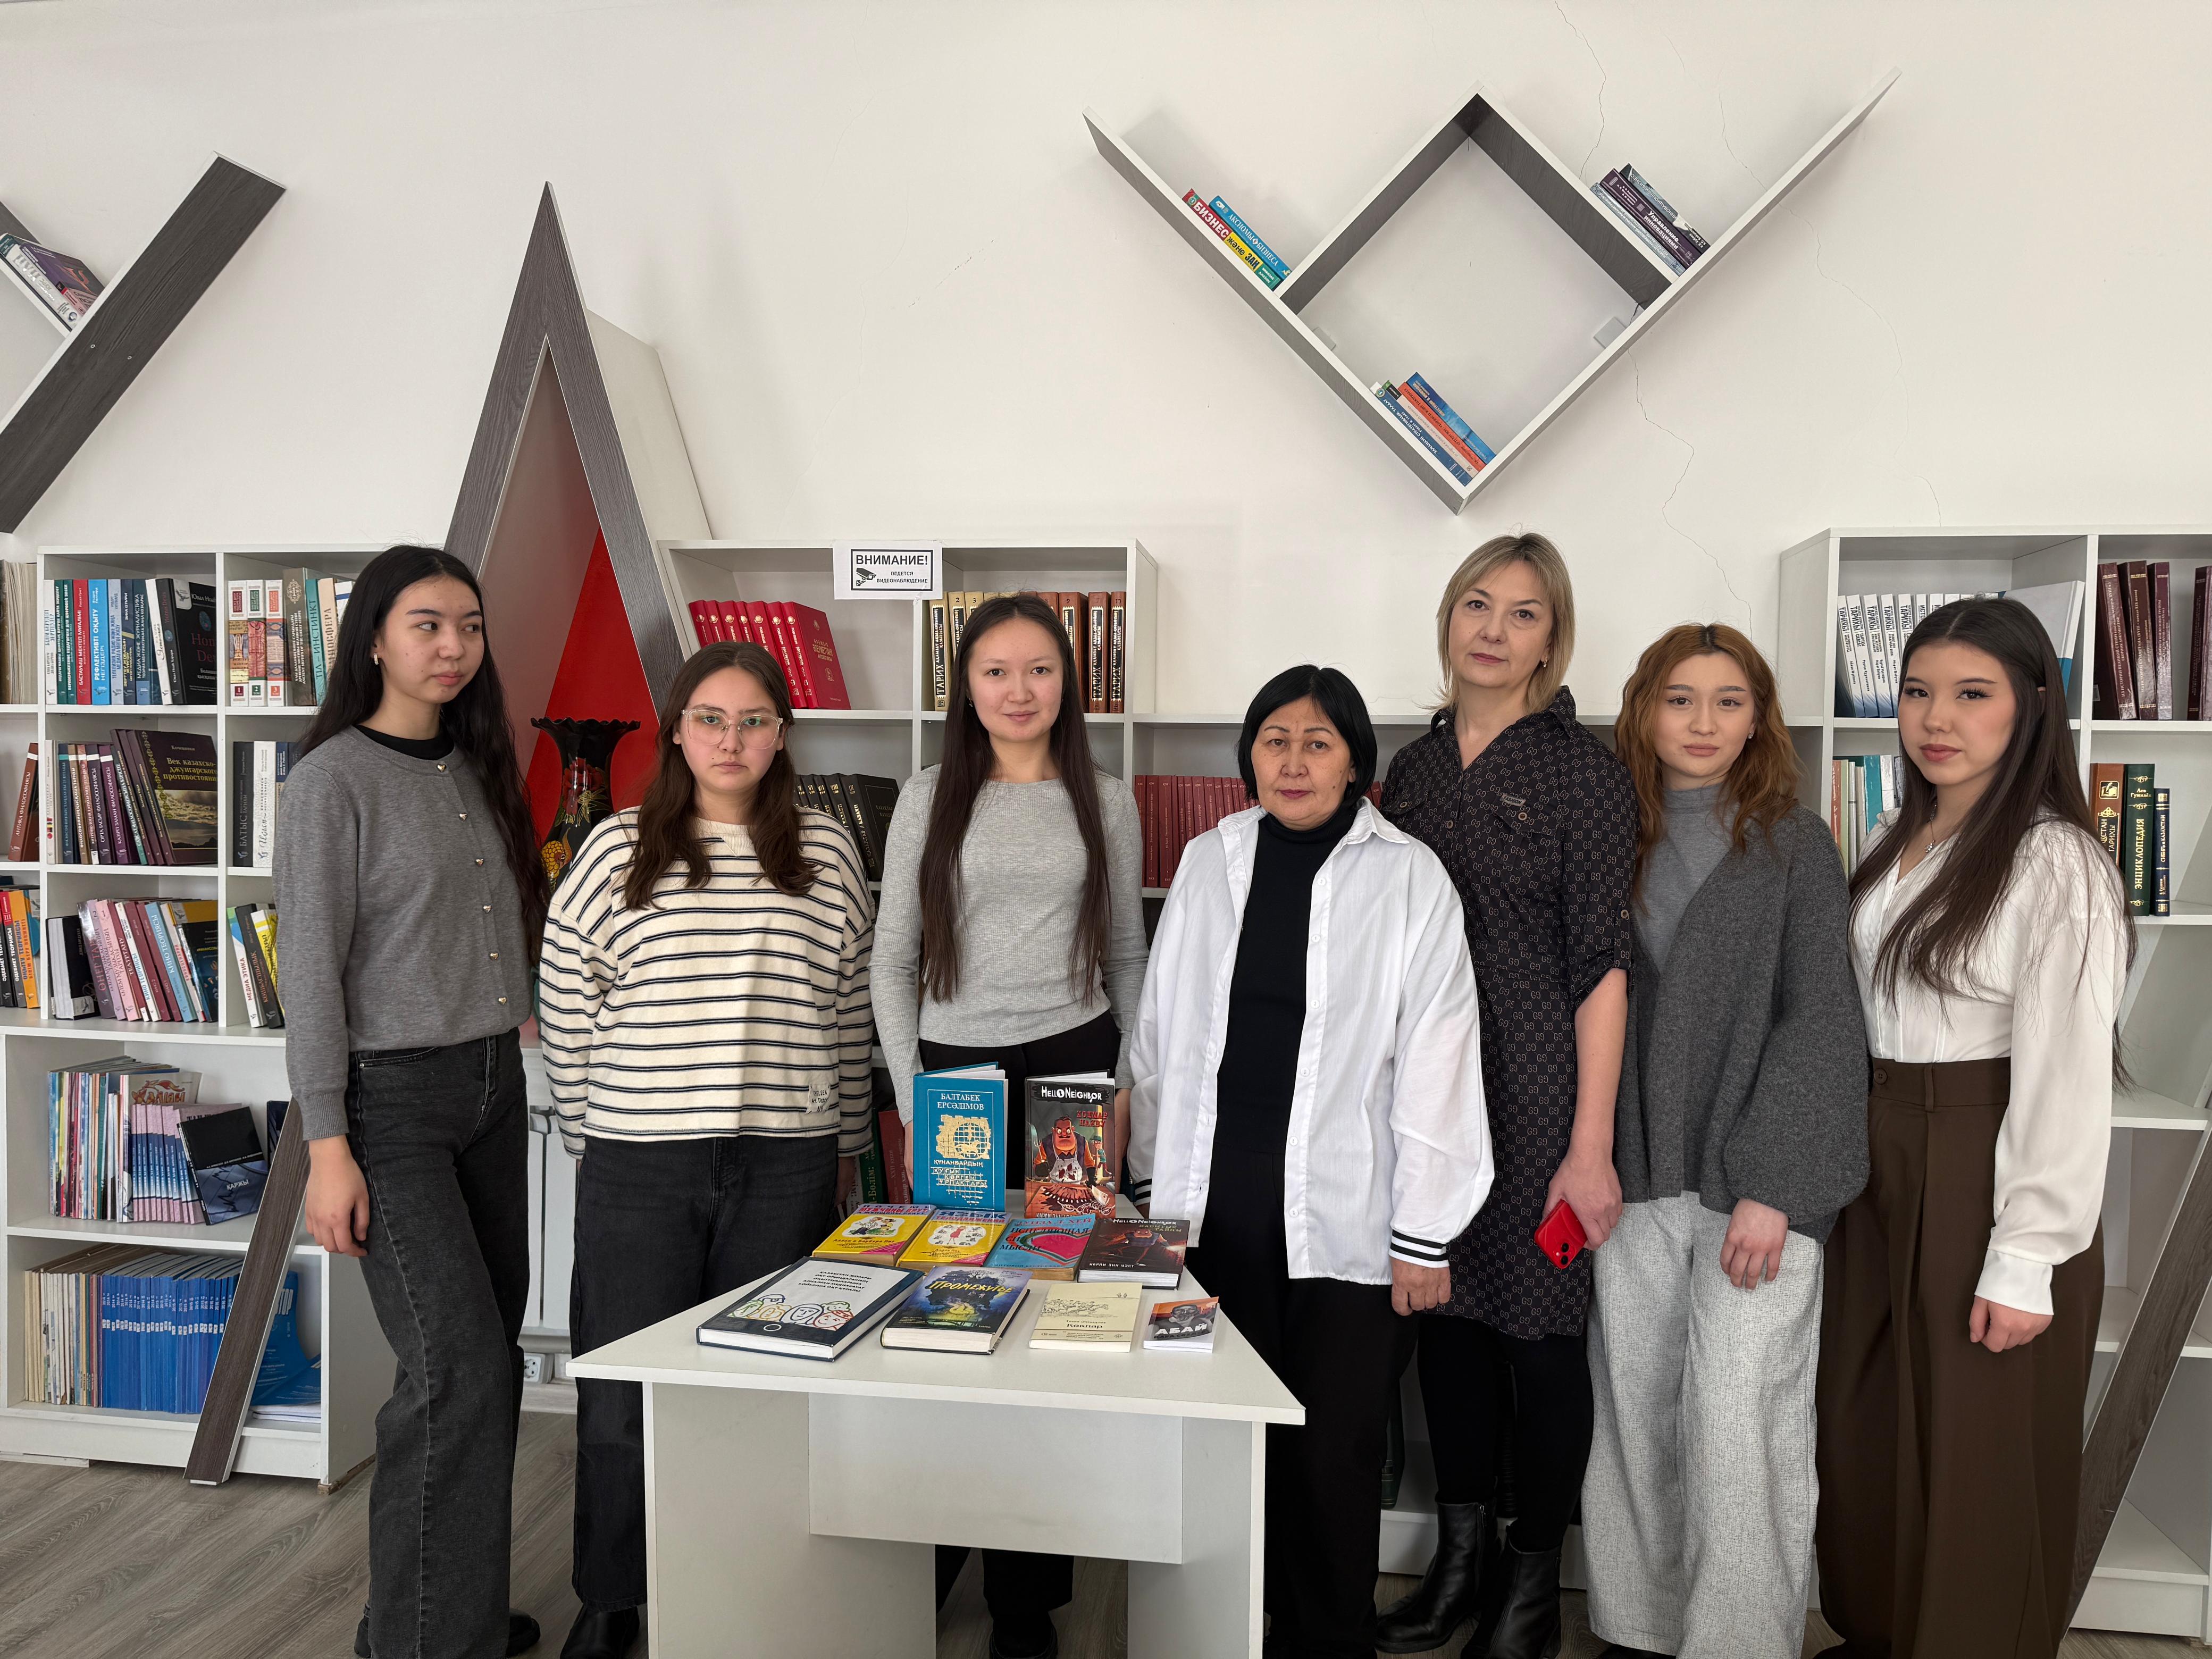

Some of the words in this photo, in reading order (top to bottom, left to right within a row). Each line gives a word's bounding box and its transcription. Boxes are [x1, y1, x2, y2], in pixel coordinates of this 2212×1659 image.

[1193, 202, 1229, 238] БИЗНЕС
[1227, 237, 1245, 255] және
[1245, 253, 1259, 270] ЗАҢ
[1228, 214, 1254, 240] АКСИОМЫ
[1256, 242, 1278, 266] БИЗНЕСА
[1644, 215, 1679, 249] инновациями
[1648, 210, 1679, 242] Управление
[856, 555, 928, 565] ВНИМАНИЕ!
[309, 599, 320, 653] ИНСТИНКТ
[1839, 607, 1847, 631] ТАРИХЫ
[1850, 606, 1860, 631] ТАРИХЫ
[1866, 606, 1875, 630] ТАРИХЫ
[1883, 606, 1892, 630] ТАРИХЫ
[1900, 605, 1909, 630] ТАРИХЫ
[936, 664, 944, 694] ТАРИХ
[1112, 667, 1121, 697] ТАРИХ
[20, 772, 31, 814] ФИЛОСОФИЯСЫ
[92, 768, 101, 812] ФИЛОСОФИЯСЫ
[106, 767, 116, 808] ФИЛОСОФИЯСЫ
[2135, 818, 2146, 890] ЭНЦИКЛОПЕДИЯ
[14, 920, 24, 954] ТЕОРИЯСЫ
[151, 914, 167, 951] ТЕОРИЯСЫ
[104, 928, 121, 978] МУЗЫКАСЫНЫҢ
[115, 949, 124, 973] ТАРИХЫ
[119, 937, 134, 976] ТЕАТРТАНУ
[132, 953, 146, 983] ТЕОРИЯСЫ
[163, 952, 175, 973] КИНО
[95, 962, 106, 991] ӨНЕР
[141, 984, 150, 1000] КИНО
[937, 1102, 984, 1110] ЕРСӘЛІМОВ
[934, 1159, 984, 1168] ҚҰНАНБАЙДЫҢ
[227, 1179, 249, 1191] ҚАРЖЫ
[928, 1280, 1016, 1293] ПРОМЕЖУТЬЕ
[1155, 1323, 1208, 1335] АБАЙ
